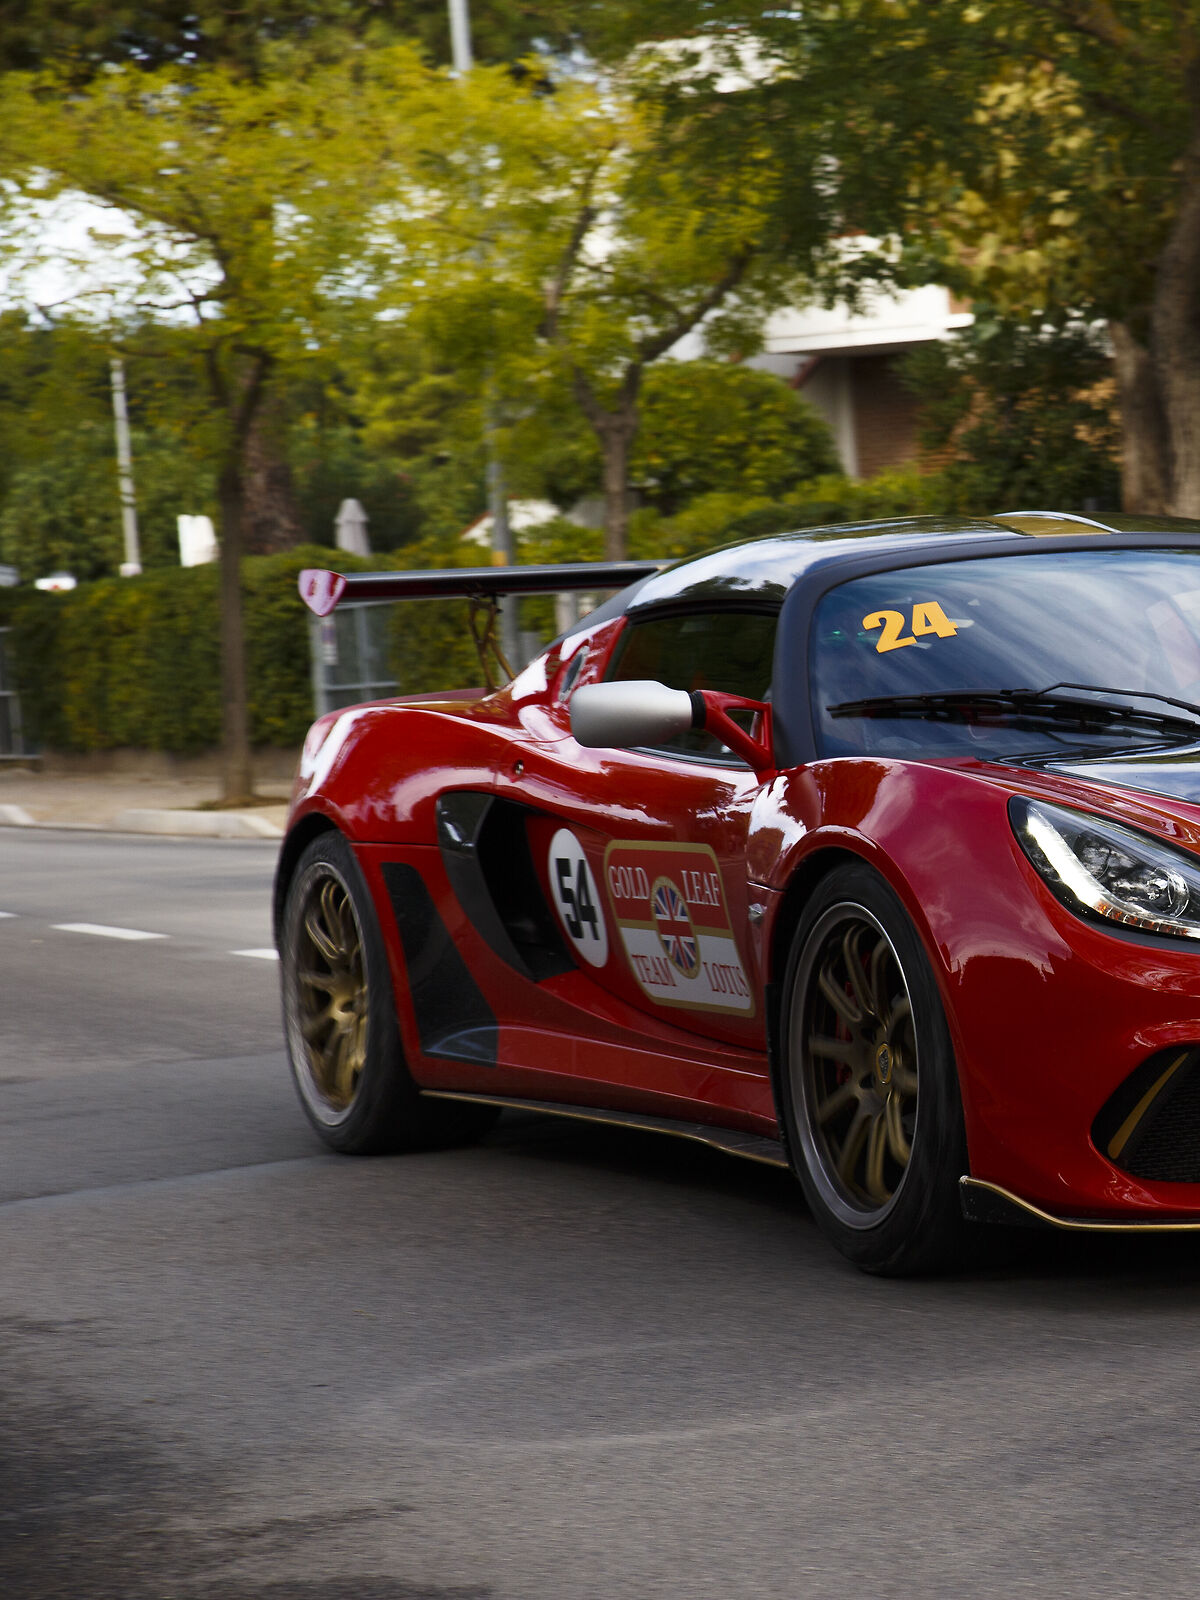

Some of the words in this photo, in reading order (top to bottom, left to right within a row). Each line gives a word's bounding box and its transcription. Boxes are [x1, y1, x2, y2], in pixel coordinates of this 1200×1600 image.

[862, 601, 959, 654] 24
[555, 857, 600, 941] 54
[608, 866, 650, 899] GOLD
[681, 870, 720, 907] LEAF
[631, 954, 677, 987] TEAM
[702, 961, 750, 998] LOTUS
